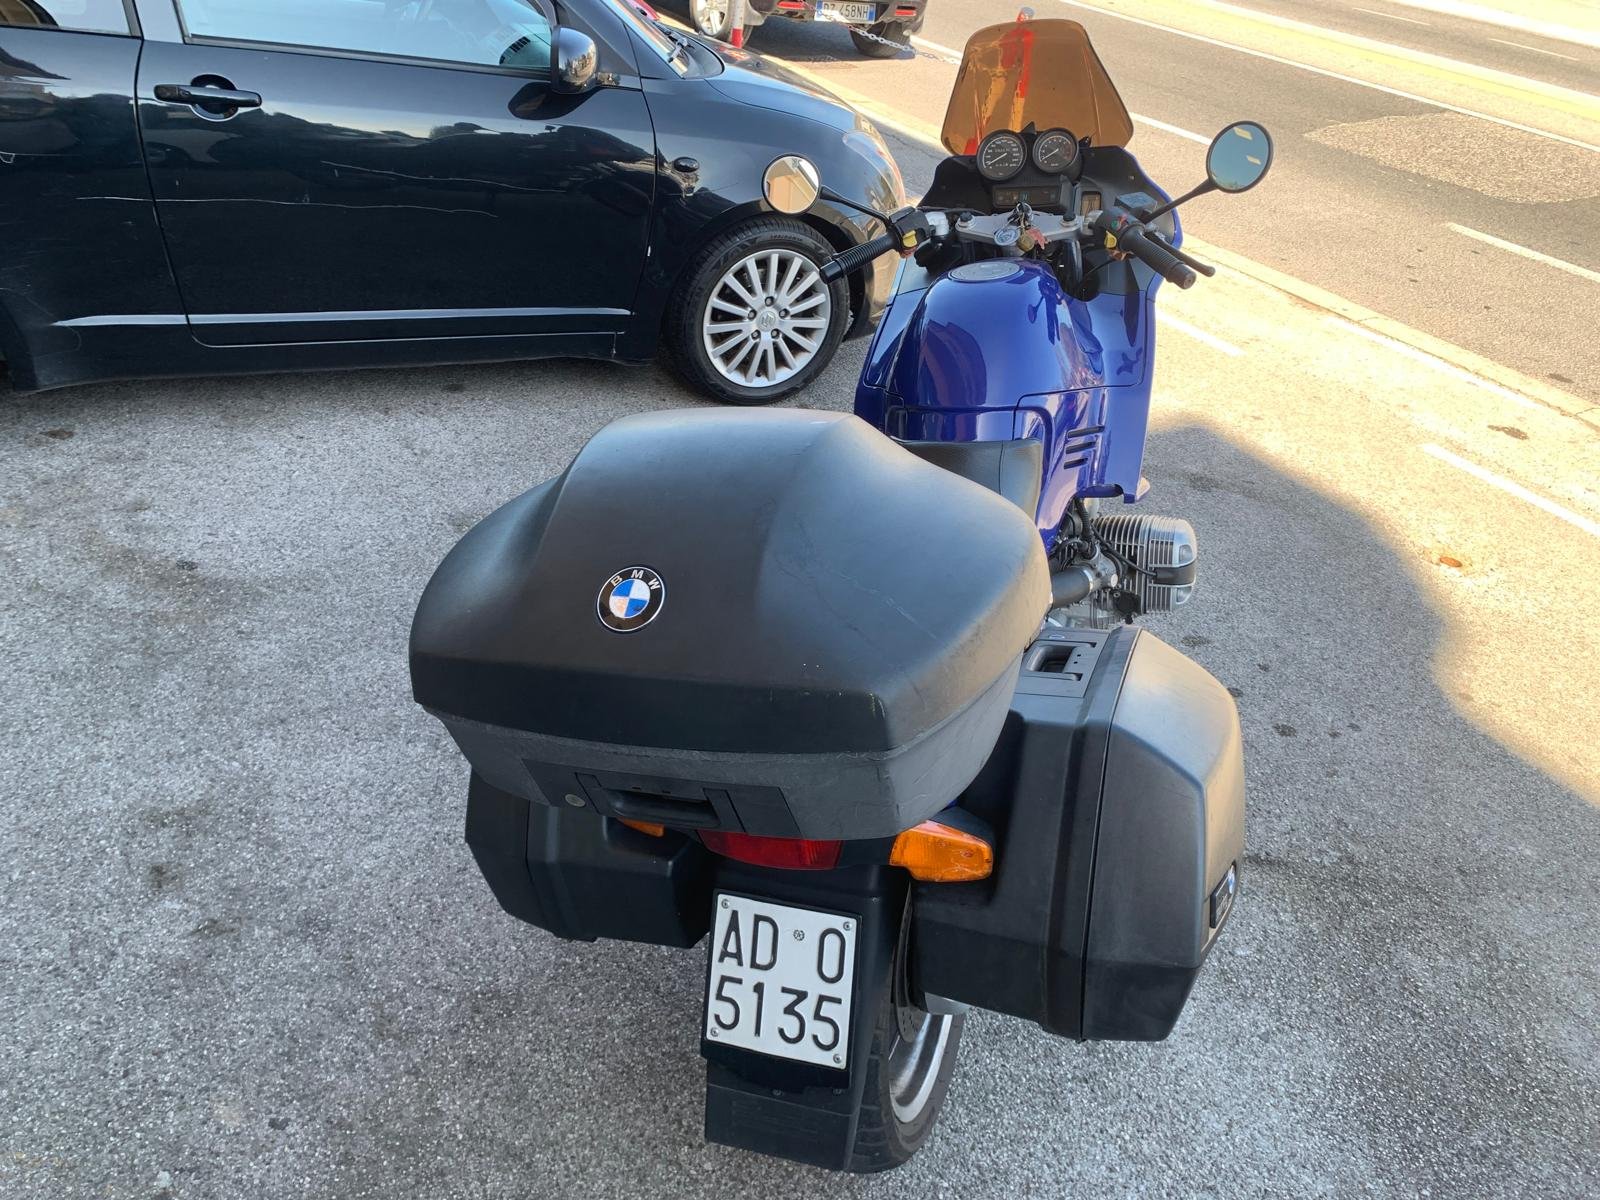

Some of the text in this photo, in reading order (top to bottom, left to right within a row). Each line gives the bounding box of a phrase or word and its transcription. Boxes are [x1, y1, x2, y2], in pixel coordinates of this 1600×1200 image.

[610, 569, 661, 590] BMW
[718, 909, 779, 971] AD
[714, 974, 842, 1051] 5135
